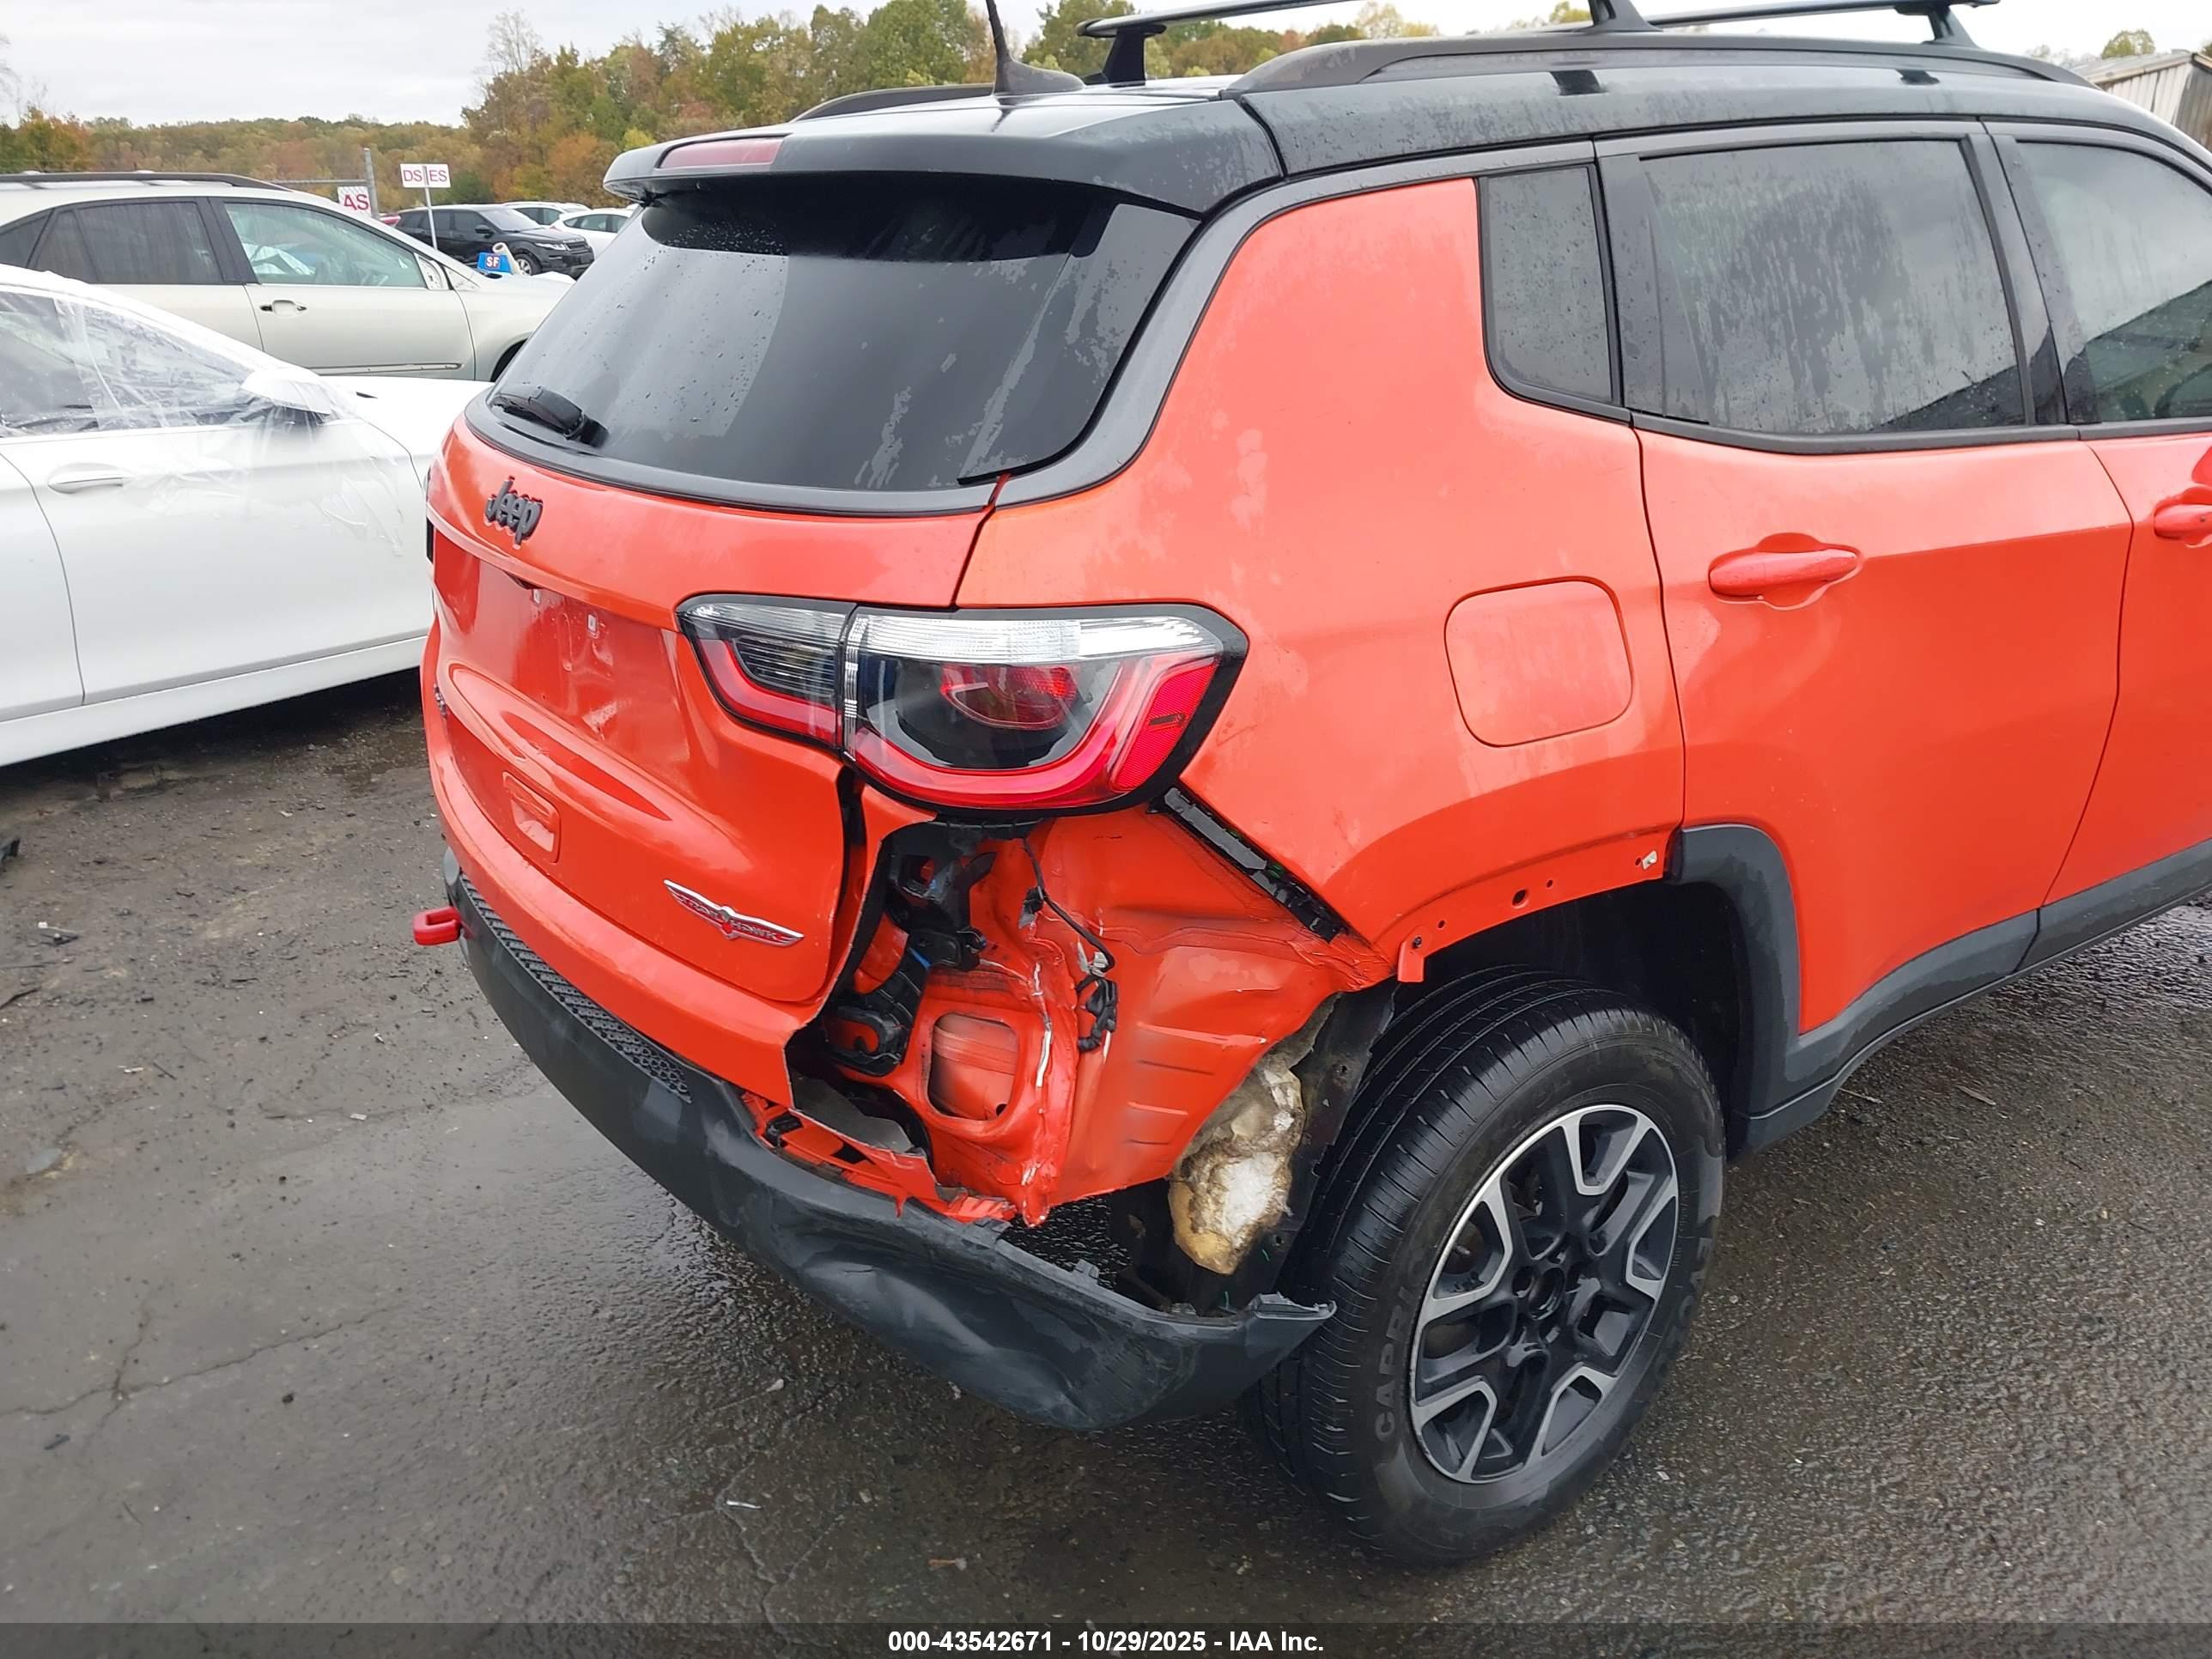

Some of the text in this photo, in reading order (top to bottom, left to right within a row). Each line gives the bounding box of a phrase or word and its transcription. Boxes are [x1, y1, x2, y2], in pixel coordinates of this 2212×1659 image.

[403, 169, 447, 182] DS ES
[343, 193, 369, 210] AS
[486, 256, 500, 268] SF
[485, 477, 543, 545] Jeep
